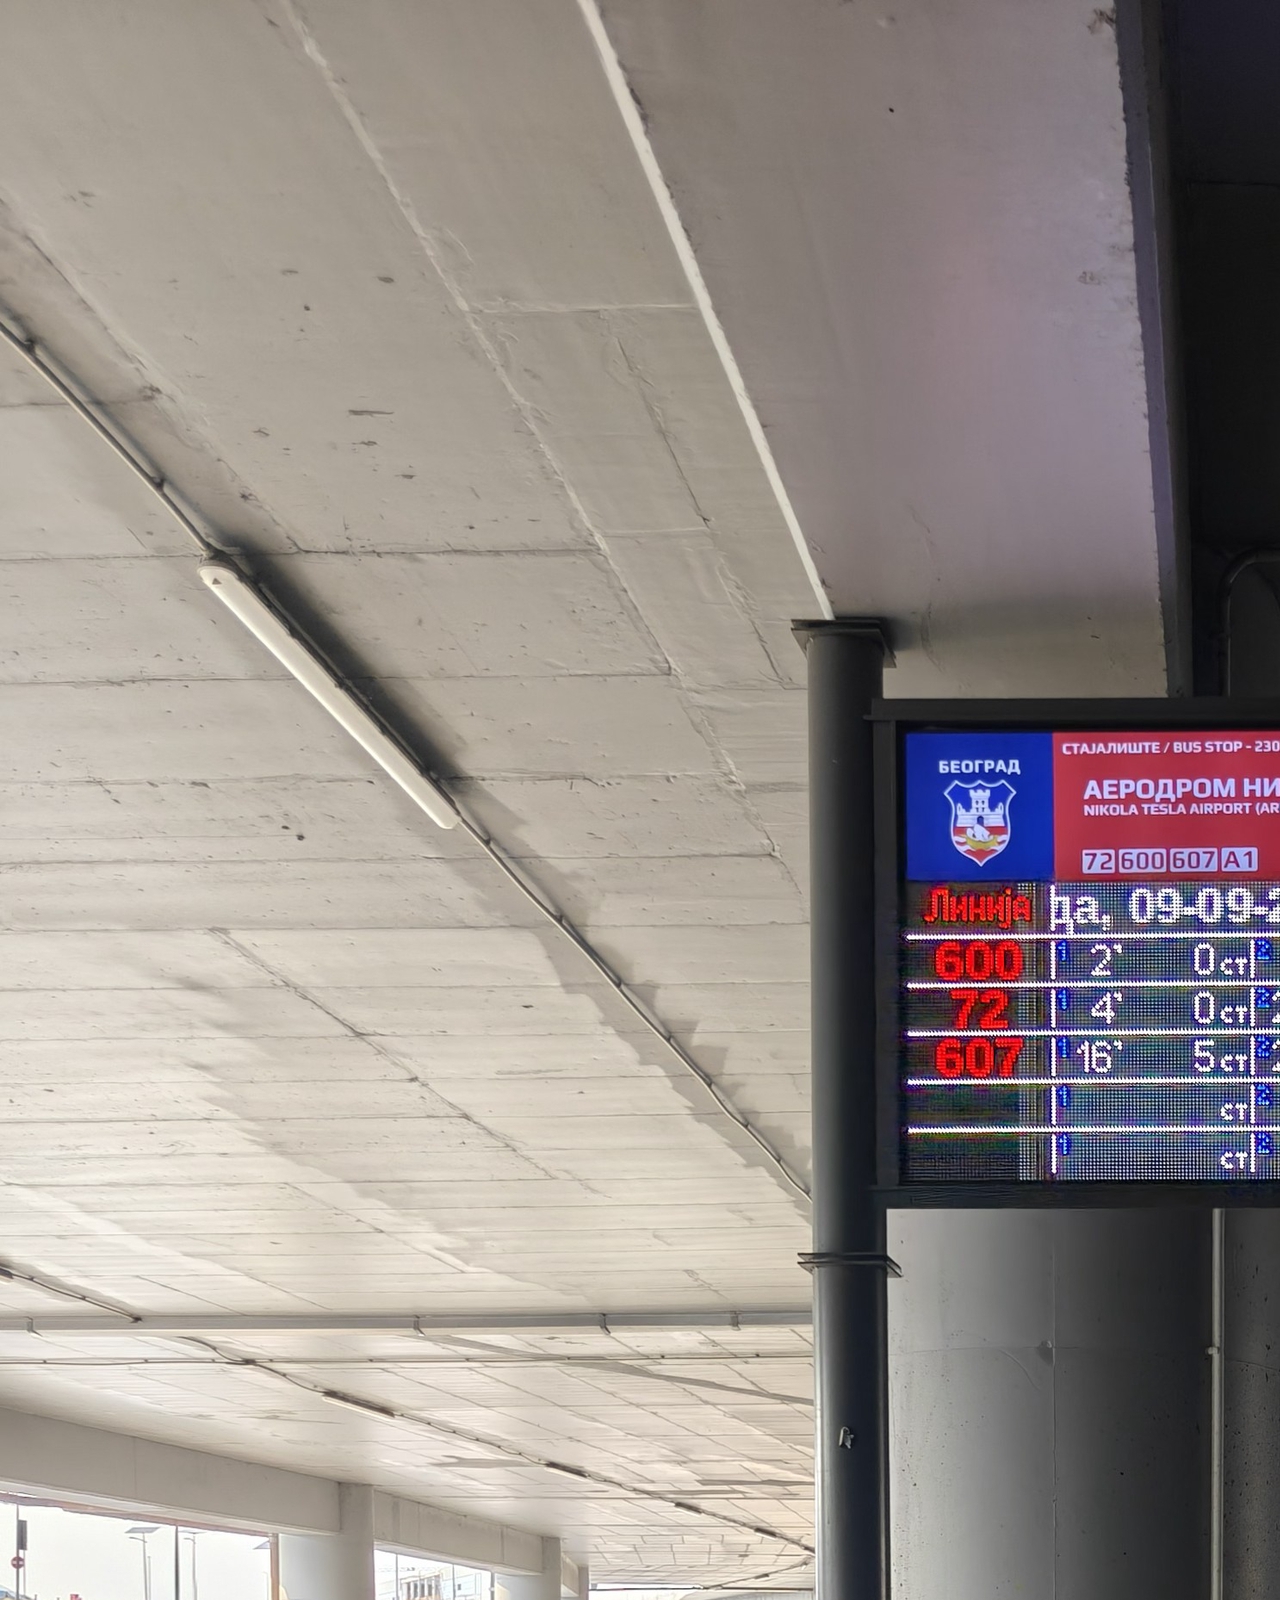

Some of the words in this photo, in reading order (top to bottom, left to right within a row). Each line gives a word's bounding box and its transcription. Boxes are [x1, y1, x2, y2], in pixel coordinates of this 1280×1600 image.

[1062, 741, 1161, 755] СТАЈАЛИШТЕ
[1173, 741, 1202, 754] BUS
[1204, 741, 1243, 754] STOP
[938, 759, 1021, 775] БЕОГРАД
[1083, 778, 1236, 802] АЕРОДРОМ
[1083, 804, 1139, 816] NIKOLA
[1141, 803, 1187, 816] TESLA
[1189, 802, 1253, 815] AIRPORT
[1084, 852, 1114, 870] 72
[1121, 851, 1165, 870] 600
[1172, 850, 1215, 869] 607
[922, 887, 1032, 929] Линија
[935, 940, 1023, 982] 600
[951, 988, 1009, 1030] 72
[935, 1037, 1024, 1079] 607
[1220, 1102, 1248, 1121] ст
[1220, 1151, 1248, 1170] ст
